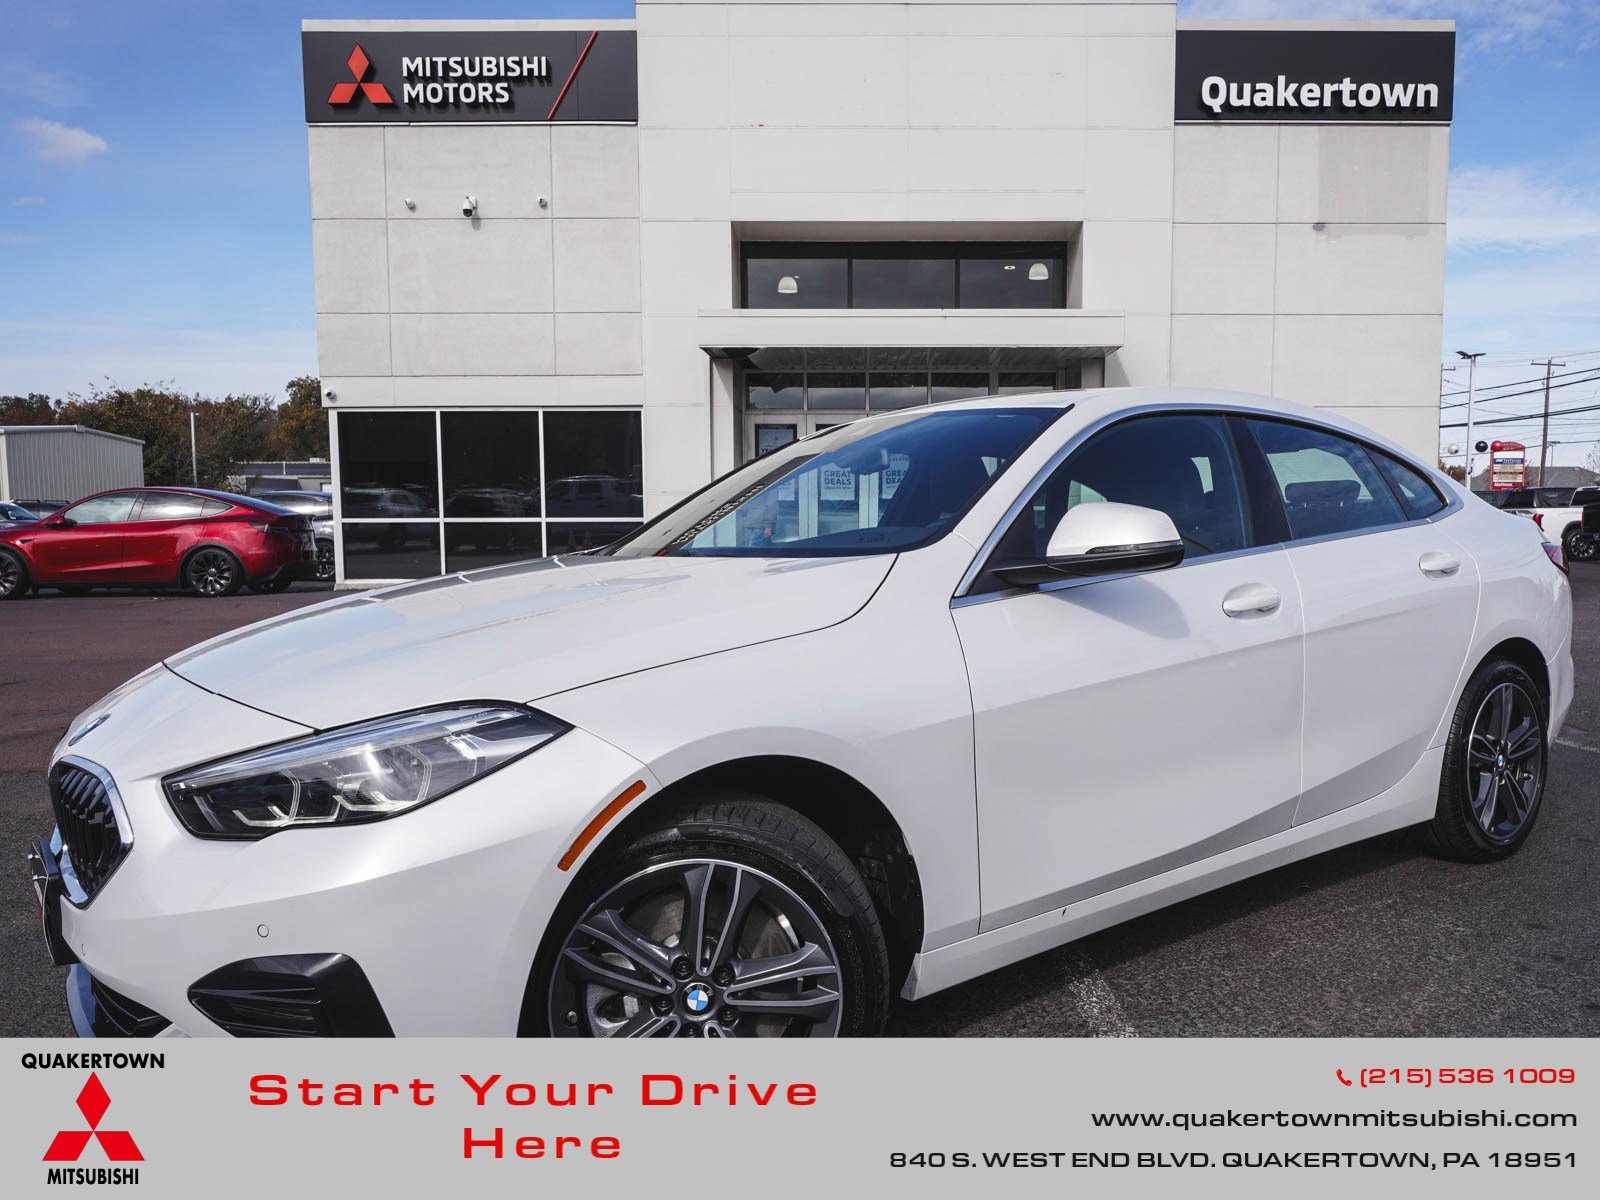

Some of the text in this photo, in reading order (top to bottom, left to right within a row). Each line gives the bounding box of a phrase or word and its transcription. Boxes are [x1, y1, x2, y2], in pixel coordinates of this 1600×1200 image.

[402, 55, 547, 77] MITSUBISHI
[403, 82, 510, 104] MOTORS
[1201, 75, 1439, 113] Quakertown
[824, 470, 852, 478] GREAT
